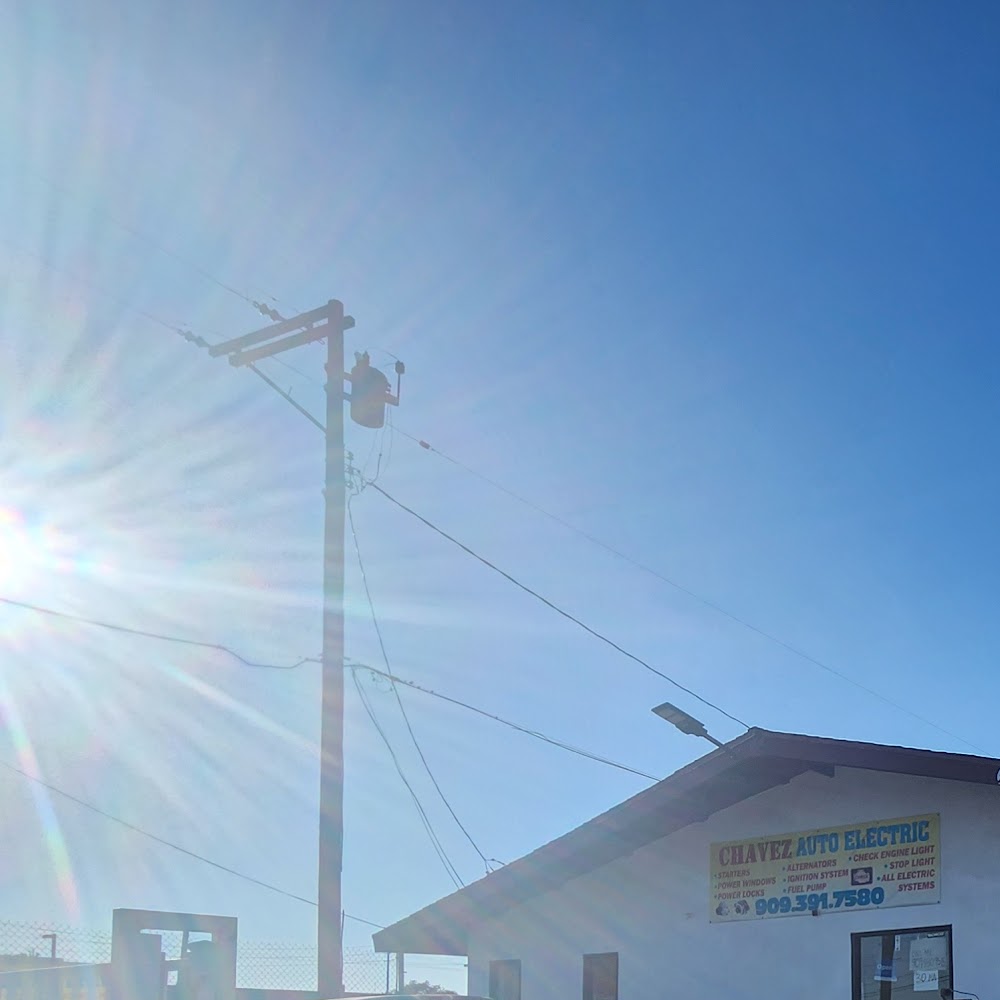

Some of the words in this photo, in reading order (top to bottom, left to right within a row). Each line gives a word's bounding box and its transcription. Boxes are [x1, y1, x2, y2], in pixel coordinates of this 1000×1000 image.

[719, 839, 792, 866] CHAVEZ
[796, 833, 839, 856] AUTO
[844, 821, 929, 850] ELECTRIC
[853, 852, 878, 862] CHECK
[881, 847, 910, 859] ENGINE
[911, 845, 935, 855] LIGHT
[787, 859, 837, 871] ALTERNATORS
[889, 860, 909, 869] STOP
[911, 857, 935, 867] LIGHT
[718, 869, 750, 879] STARTERS
[787, 872, 818, 883] IGNITION
[820, 869, 848, 879] SYSTEM
[881, 873, 895, 882] ALL
[897, 869, 935, 880] ELECTRIC
[718, 880, 740, 889] POWER
[742, 877, 776, 887] WINDOWS
[788, 885, 805, 893] FUEL
[806, 883, 827, 892] PUMP
[898, 881, 935, 892] SYSTEMS
[718, 891, 740, 900] POWER
[742, 889, 765, 897] LOCKS
[755, 887, 885, 915] 909.391.7580
